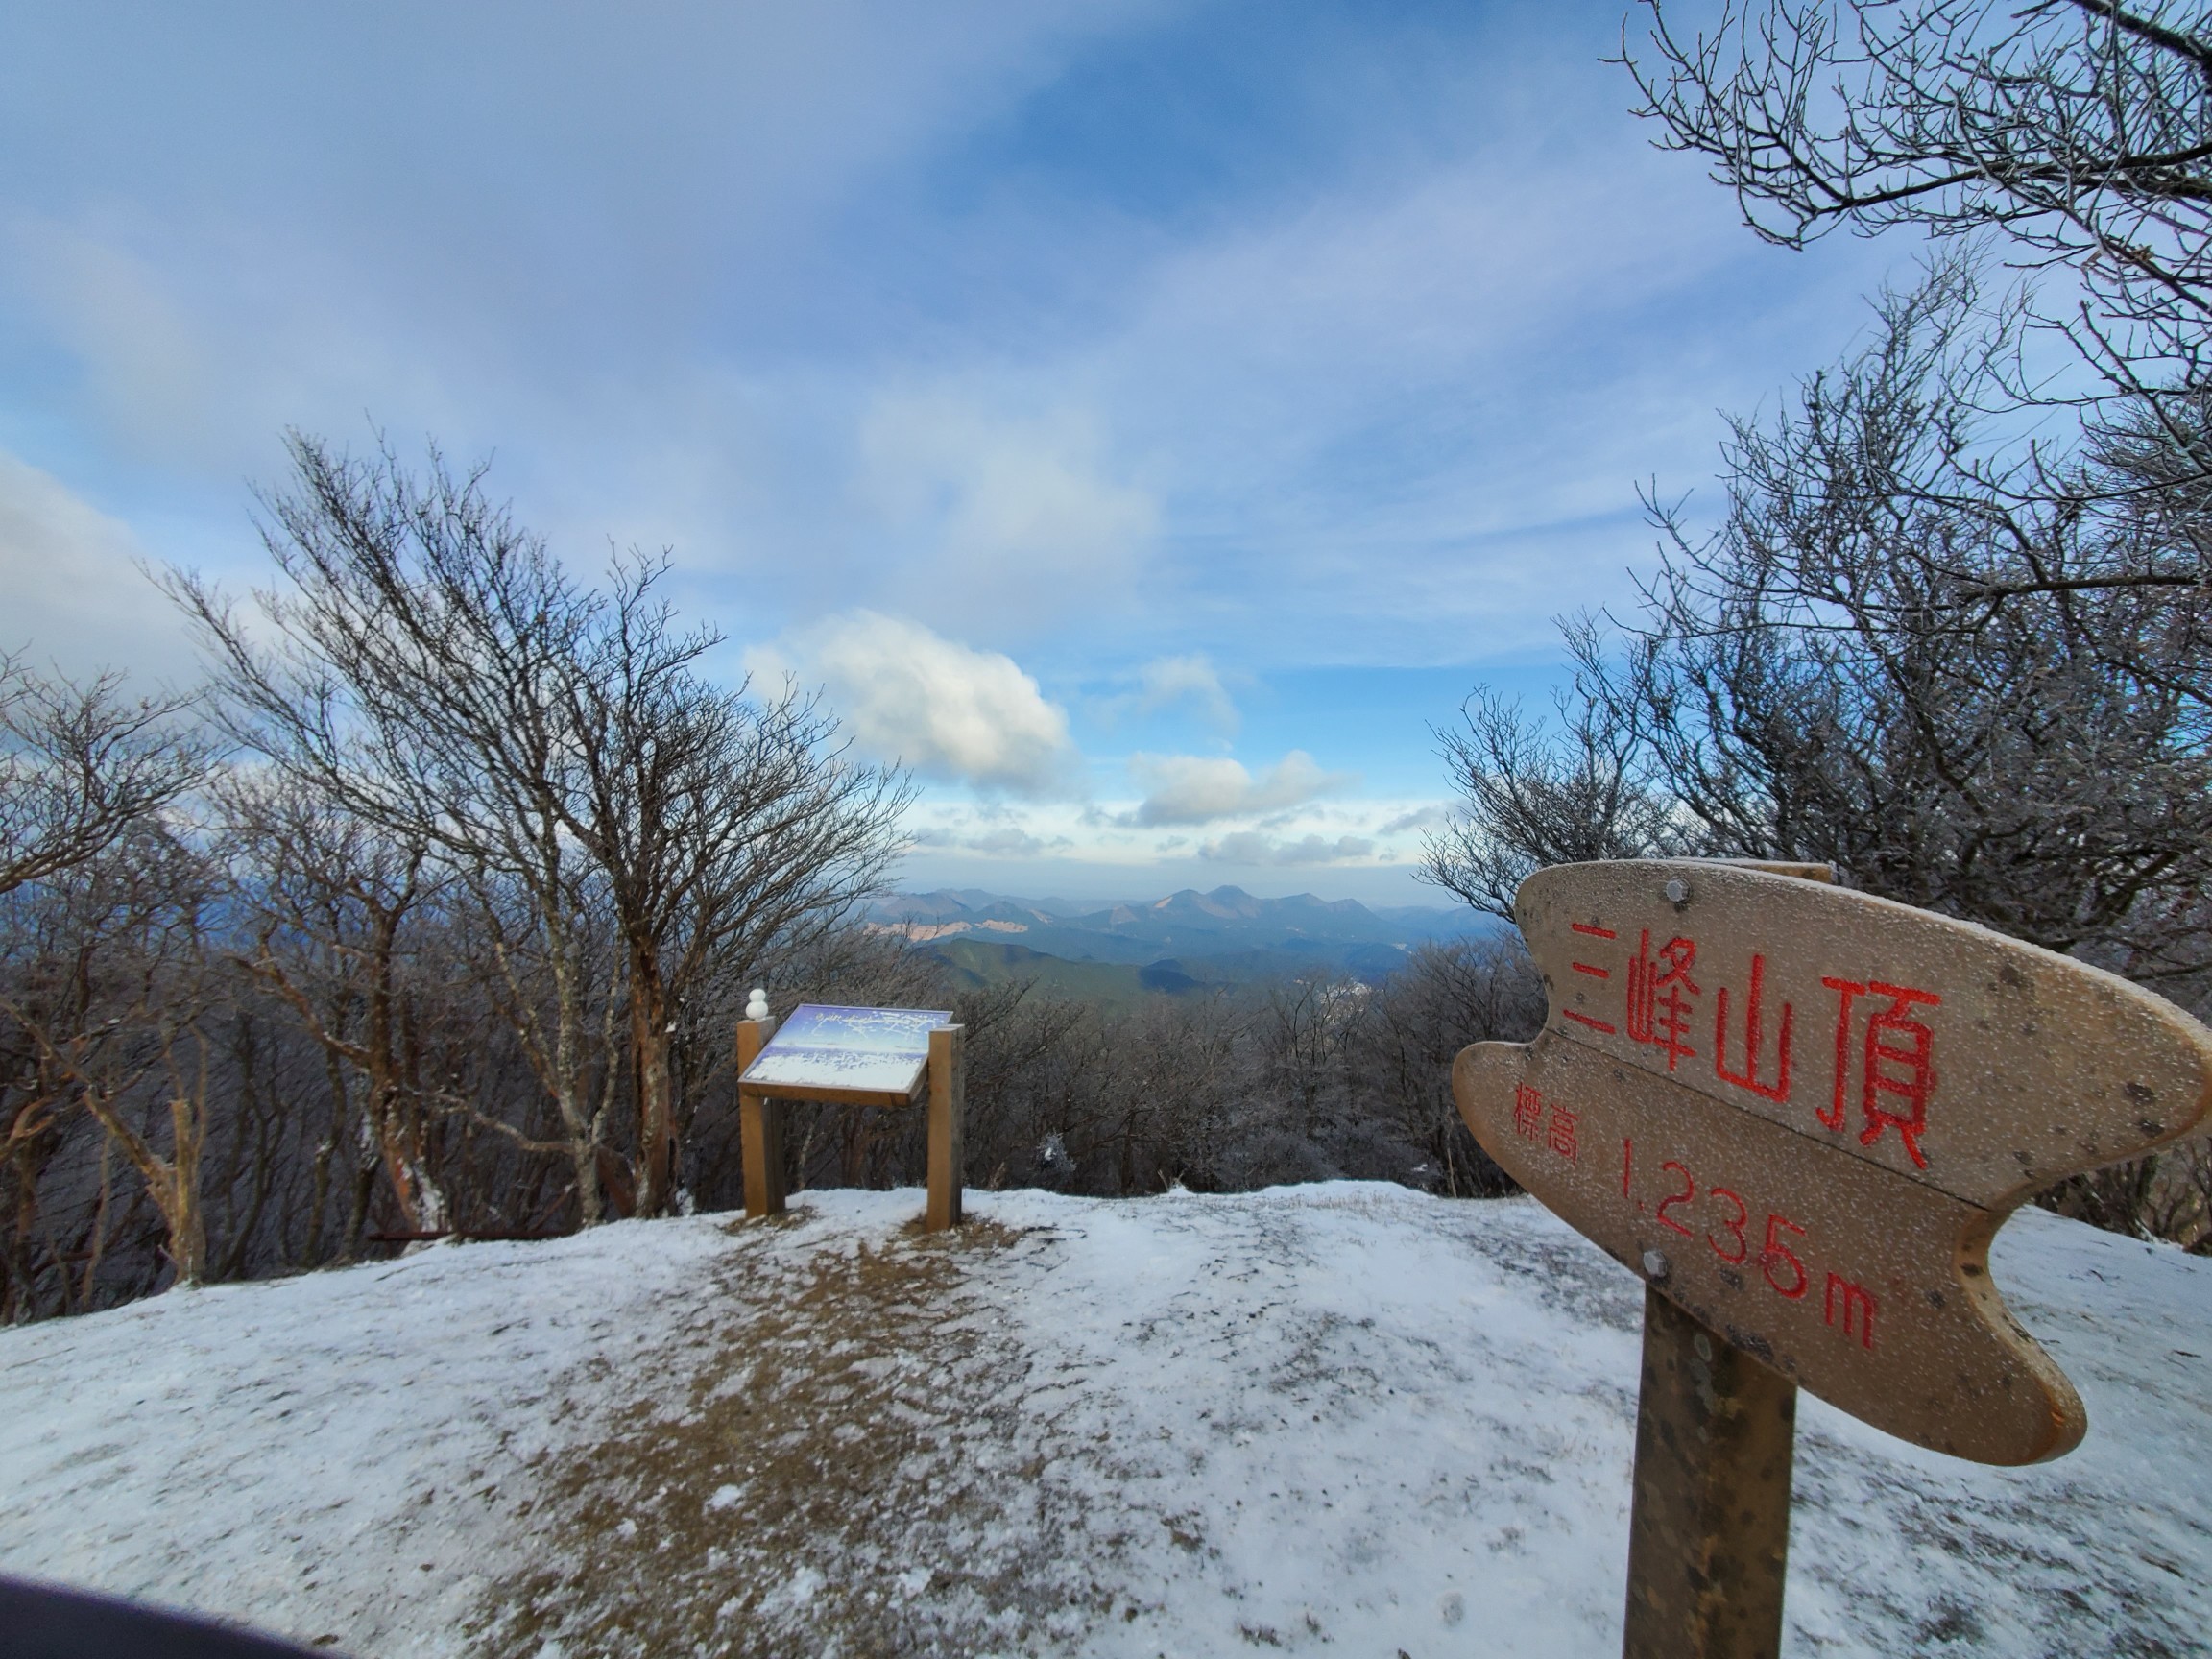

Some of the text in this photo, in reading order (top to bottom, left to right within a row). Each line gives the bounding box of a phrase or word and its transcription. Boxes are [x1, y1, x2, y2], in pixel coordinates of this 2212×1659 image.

[1514, 1082, 1579, 1167] 標高
[1565, 923, 1940, 1169] 三峰山頂
